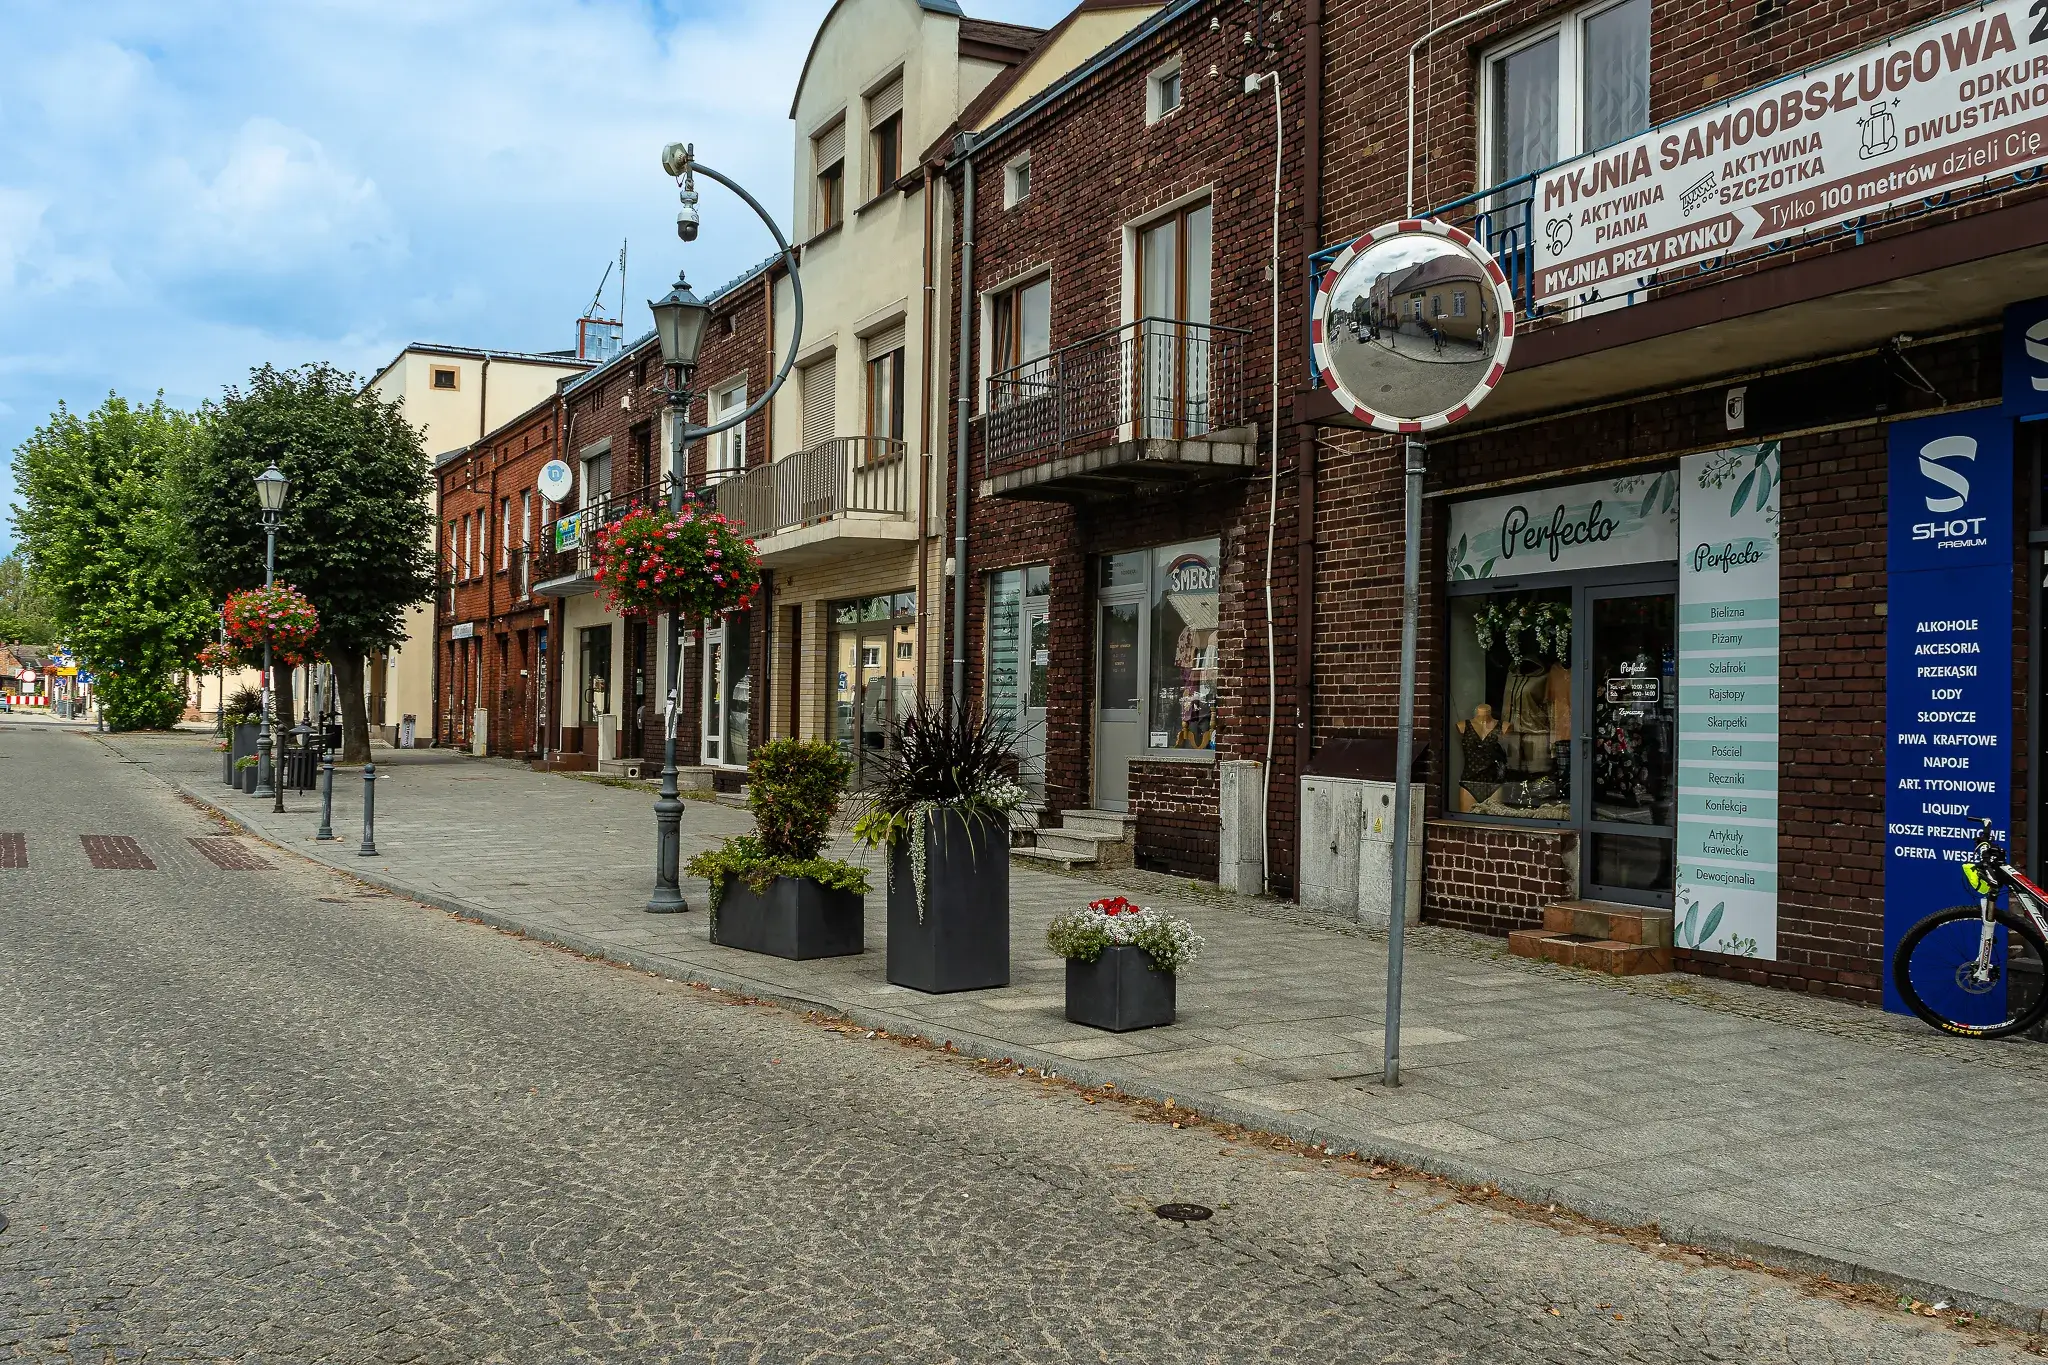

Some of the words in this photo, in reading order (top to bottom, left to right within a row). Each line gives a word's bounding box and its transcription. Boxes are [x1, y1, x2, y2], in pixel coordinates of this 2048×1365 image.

[1959, 54, 2048, 103] ODKUR
[1544, 150, 1653, 213] MYJNIA
[1659, 13, 2017, 171] SAMOOBSŁUGOWA
[1904, 83, 2048, 148] DWUSTANO
[1720, 131, 1823, 181] AKTYWNA
[1719, 155, 1825, 205] SZCZOTKA
[1769, 201, 1816, 229] Tylko
[1820, 184, 1853, 211] 100
[1857, 160, 1937, 197] metrów
[1942, 140, 2000, 176] dzieli
[2005, 130, 2041, 157] Cię
[1580, 184, 1665, 227] AKTYWNA
[1595, 214, 1648, 244] PIANA
[1544, 259, 1607, 295] MYJNIA
[1612, 243, 1662, 278] PRZY
[1665, 219, 1732, 265] RYNKU
[1501, 499, 1620, 563] Perfecto
[1912, 517, 1987, 541] SHOT
[1938, 538, 1987, 549] PREMIUM
[1694, 540, 1764, 574] Perfecto
[1171, 566, 1217, 592] SMERF
[1710, 606, 1746, 619] Bielizna
[1916, 619, 1978, 633] ALKOHOLE
[1711, 632, 1743, 644] Piżamy
[1915, 642, 1980, 655] AKCESORIA
[1709, 660, 1746, 675] Szlafroki
[1917, 665, 1977, 679] PRZEKĄSKI
[1709, 687, 1745, 702] Rajstopy
[1931, 688, 1962, 701] LODY
[1707, 715, 1748, 730] Skarpetki
[1917, 711, 1976, 723] SŁODYCZE
[1898, 734, 1927, 745] PIWA
[1933, 734, 1997, 746] KRAFTOWE
[1711, 744, 1742, 758] Pościel
[1923, 757, 1969, 769] NAPOJE
[1708, 772, 1745, 786] Ręczniki
[1898, 779, 1921, 791] ART.
[1924, 780, 1995, 793] TYTONIOWE
[1705, 800, 1747, 815] Konfekcja
[1922, 803, 1970, 816] LIQUIDY
[1709, 829, 1744, 843] Artykuły
[1888, 823, 1924, 836] KOSZE
[1702, 842, 1750, 857] krawieckie
[1894, 846, 1936, 860] OFERTA
[1696, 869, 1755, 885] Dewocjonalia
